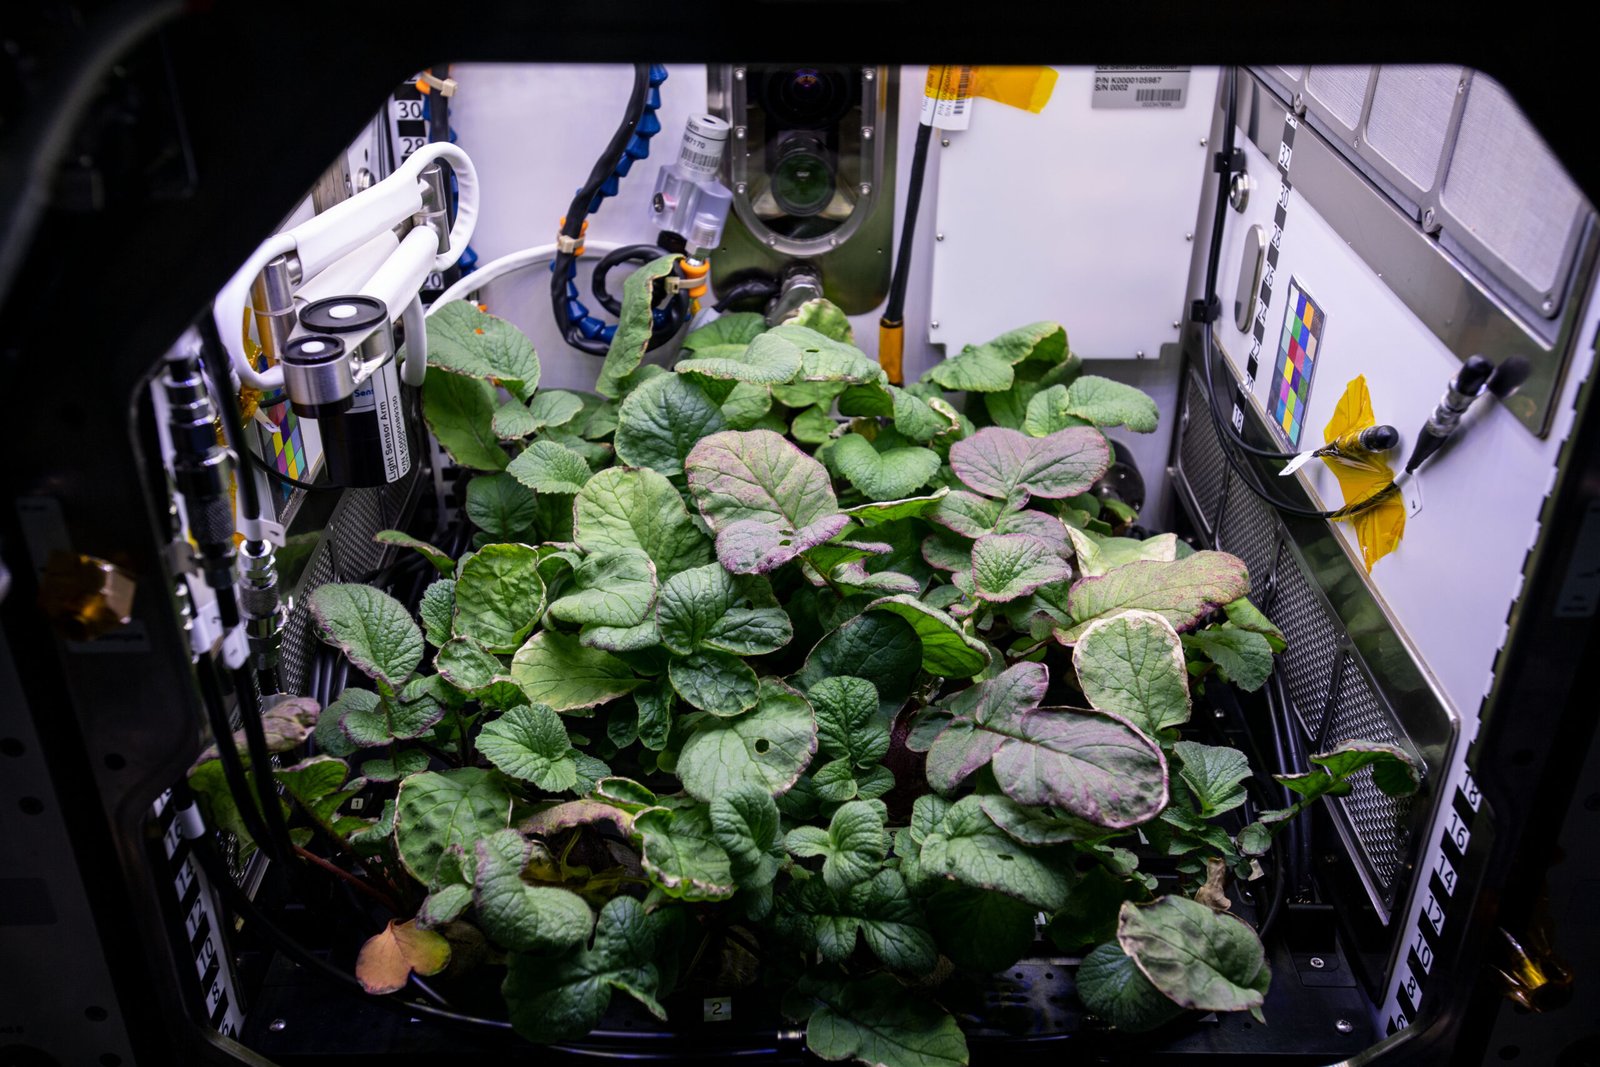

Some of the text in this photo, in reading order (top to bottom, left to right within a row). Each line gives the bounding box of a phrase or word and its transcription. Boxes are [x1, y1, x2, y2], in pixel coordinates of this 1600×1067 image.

[398, 101, 421, 119] 30
[403, 138, 425, 154] 28
[1279, 144, 1291, 169] 32
[1278, 185, 1290, 209] 30
[1271, 225, 1282, 249] 28
[1264, 264, 1274, 288] 26
[1257, 302, 1267, 324] 24
[1250, 338, 1259, 362] 22
[1234, 407, 1243, 430] 18
[380, 401, 398, 480] Light Sensor Arm
[1450, 813, 1466, 849] 16
[177, 857, 194, 891] 14
[1438, 854, 1454, 891] 14
[189, 897, 206, 932] 12
[1427, 895, 1443, 931] 12
[200, 937, 213, 970] 10
[1416, 933, 1431, 969] 10
[212, 982, 220, 1004] 8
[1406, 976, 1417, 999] 8
[712, 1001, 723, 1015] 2
